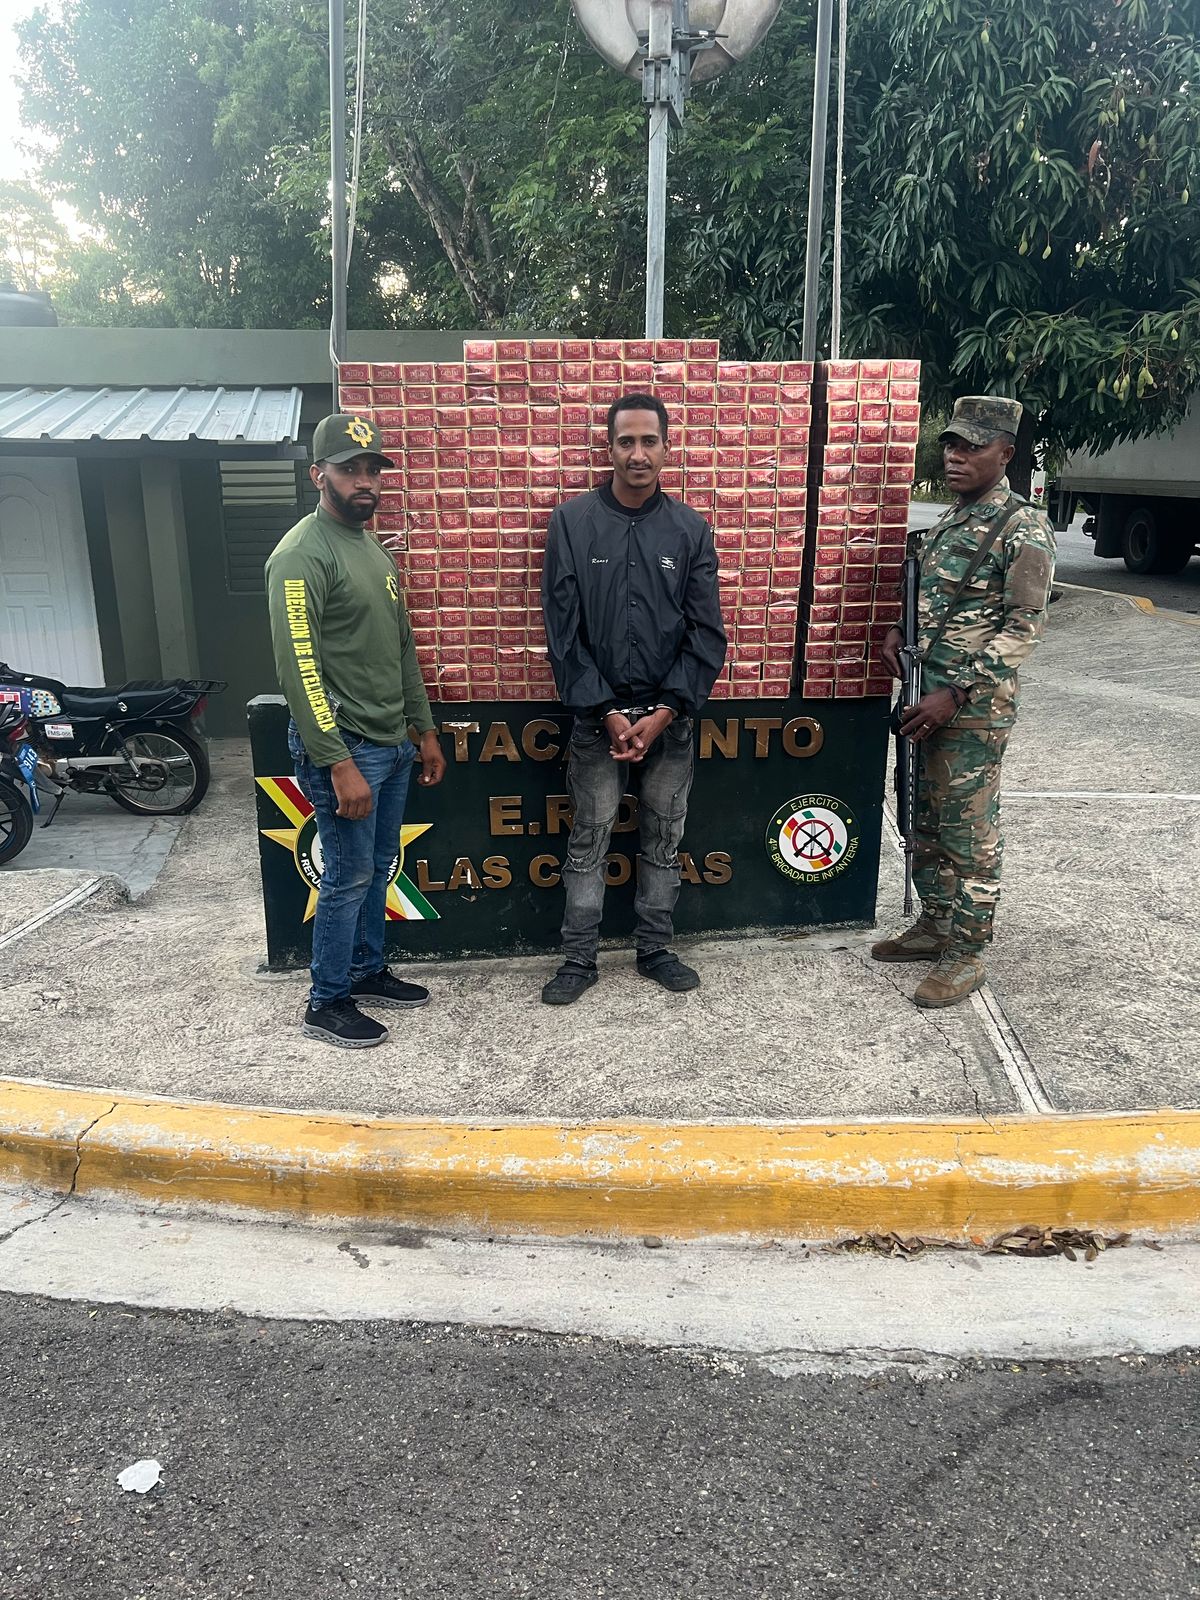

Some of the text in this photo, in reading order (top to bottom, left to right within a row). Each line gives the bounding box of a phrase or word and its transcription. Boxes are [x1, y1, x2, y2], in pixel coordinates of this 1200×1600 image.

[284, 579, 337, 733] DIRECCION DE INTELIGENCIA
[790, 797, 839, 811] EJERCITO
[416, 851, 733, 892] LAS COAS
[771, 852, 805, 881] BRIGADA
[806, 873, 820, 882] DE
